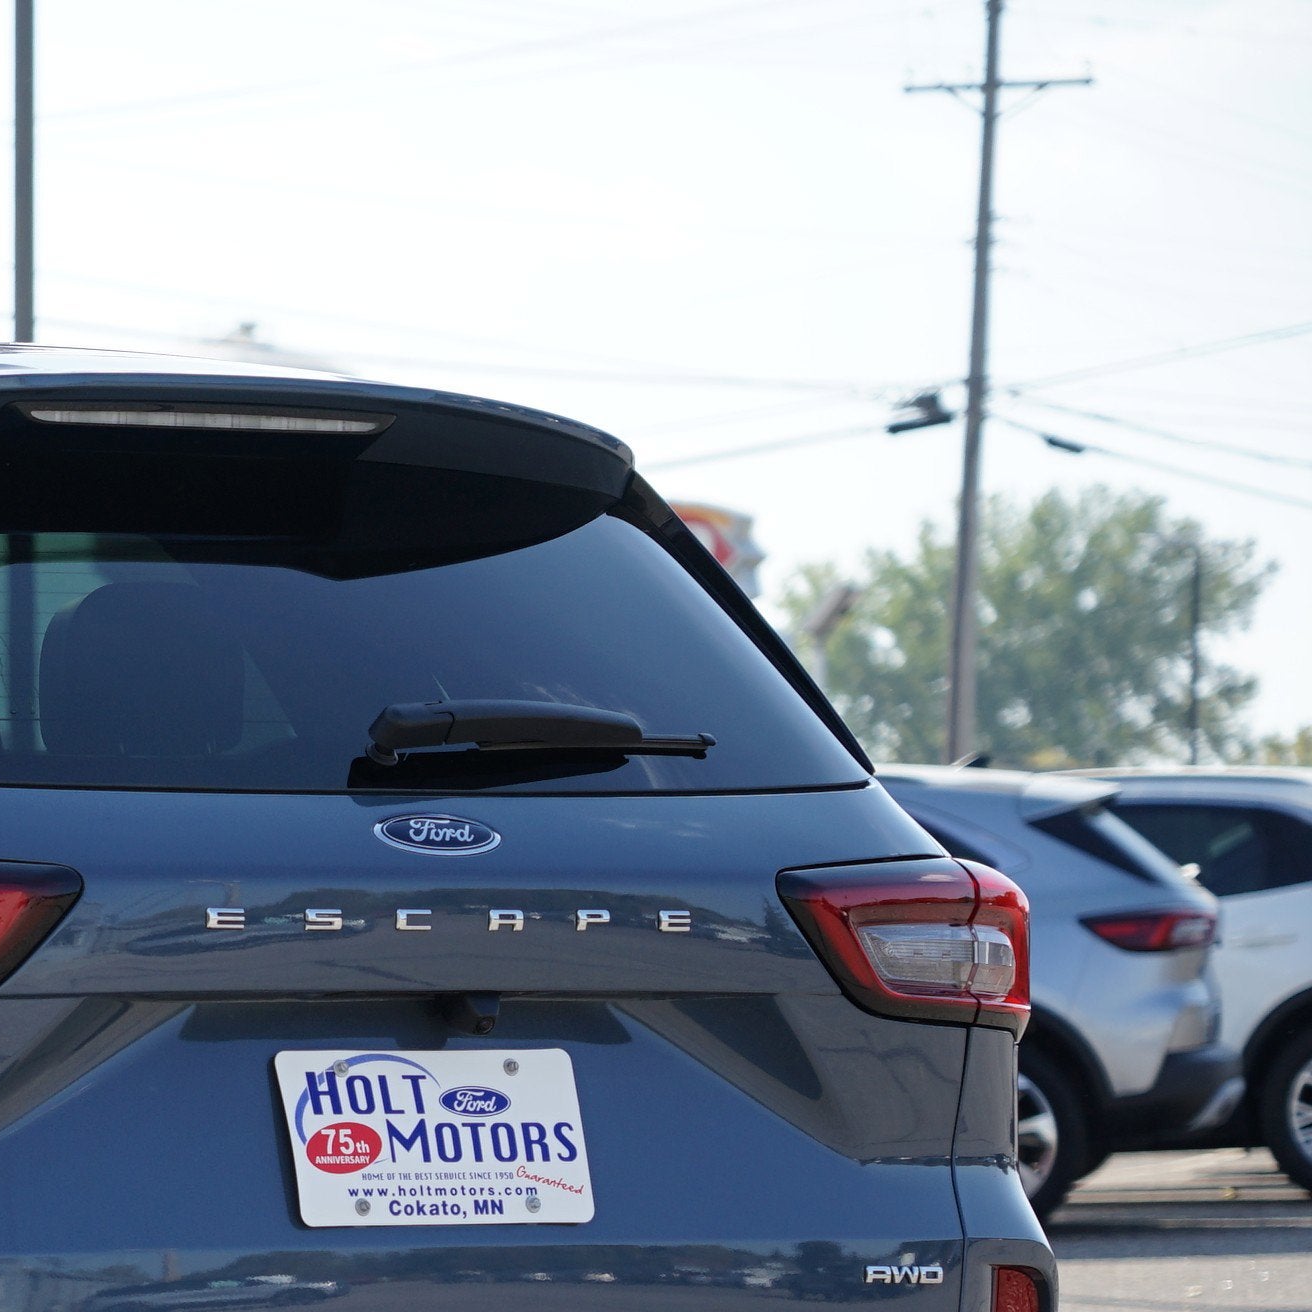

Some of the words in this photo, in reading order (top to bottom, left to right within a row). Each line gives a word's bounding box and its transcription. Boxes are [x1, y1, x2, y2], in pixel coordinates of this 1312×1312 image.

[409, 817, 475, 843] Ford
[205, 907, 692, 932] ESCAPE
[305, 1071, 427, 1115] HOLT
[453, 1090, 498, 1112] Ford
[320, 1128, 370, 1155] 75th
[385, 1118, 578, 1163] MOTORS
[315, 1155, 370, 1164] ANNIVERSARY
[361, 1172, 384, 1181] HOME
[386, 1172, 397, 1181] OF
[398, 1172, 412, 1181] THE
[415, 1172, 433, 1181] BEST
[434, 1172, 467, 1180] SERVICE
[469, 1171, 491, 1180] SINCE
[495, 1171, 514, 1180] 1950
[516, 1165, 585, 1195] Guaranteed
[347, 1185, 538, 1197] www.holtmotors.com
[388, 1199, 467, 1218] Cokato,
[473, 1199, 504, 1215] MN
[865, 1265, 944, 1284] AWD
